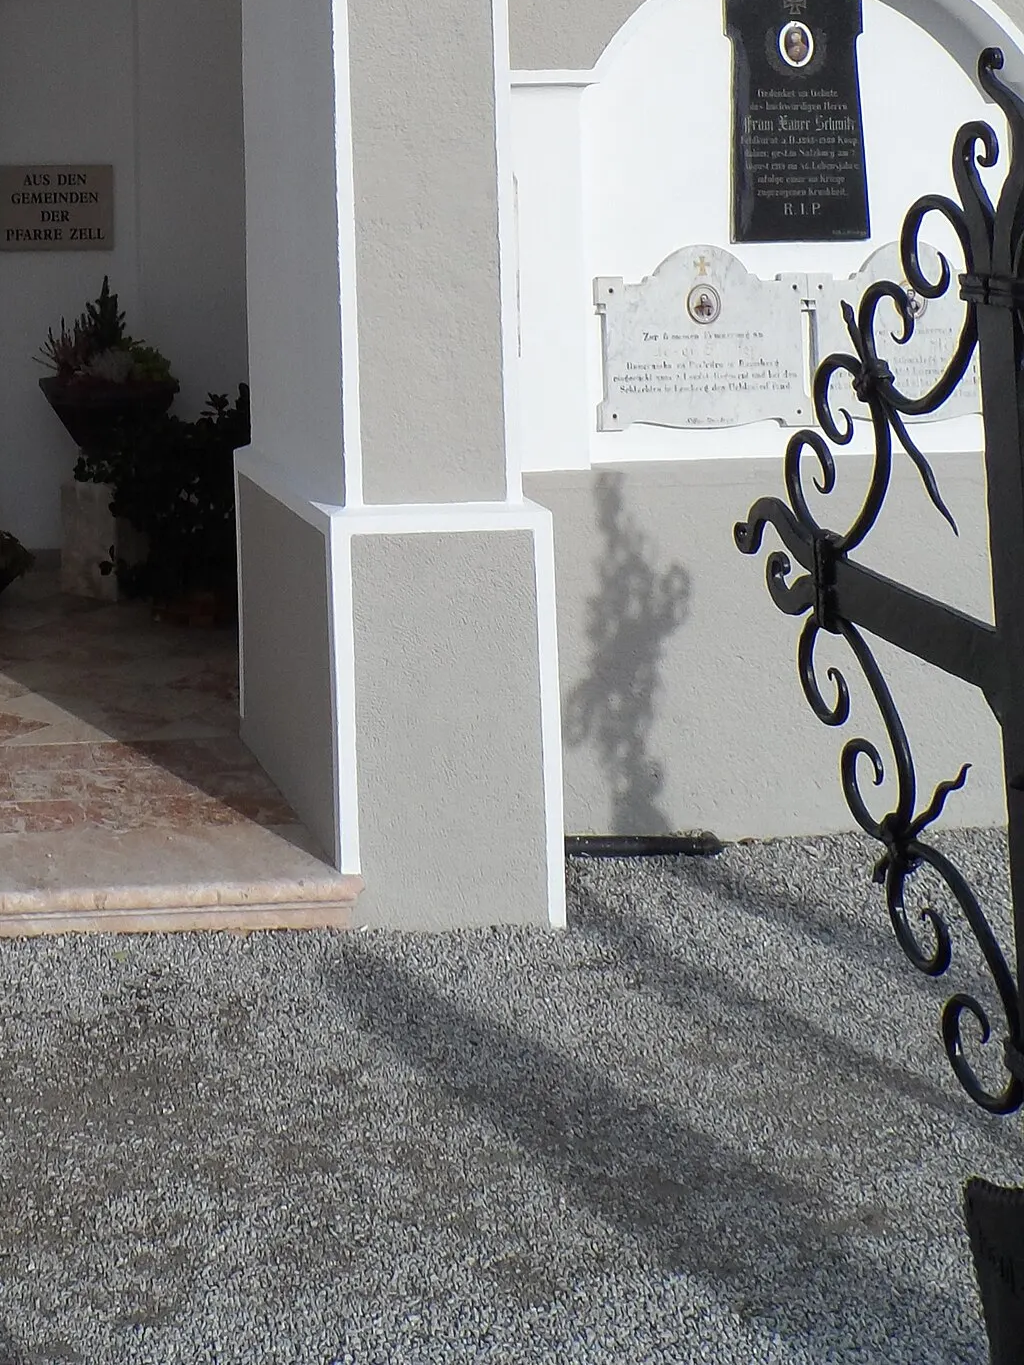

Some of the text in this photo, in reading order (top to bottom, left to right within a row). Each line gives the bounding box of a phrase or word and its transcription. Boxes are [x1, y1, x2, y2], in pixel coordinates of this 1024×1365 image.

[778, 114, 811, 132] Xaver
[23, 173, 87, 186] AUS DEN
[11, 192, 98, 204] GEMEINDEN
[40, 210, 70, 222] DER
[6, 228, 105, 242] PFARRE ZELL
